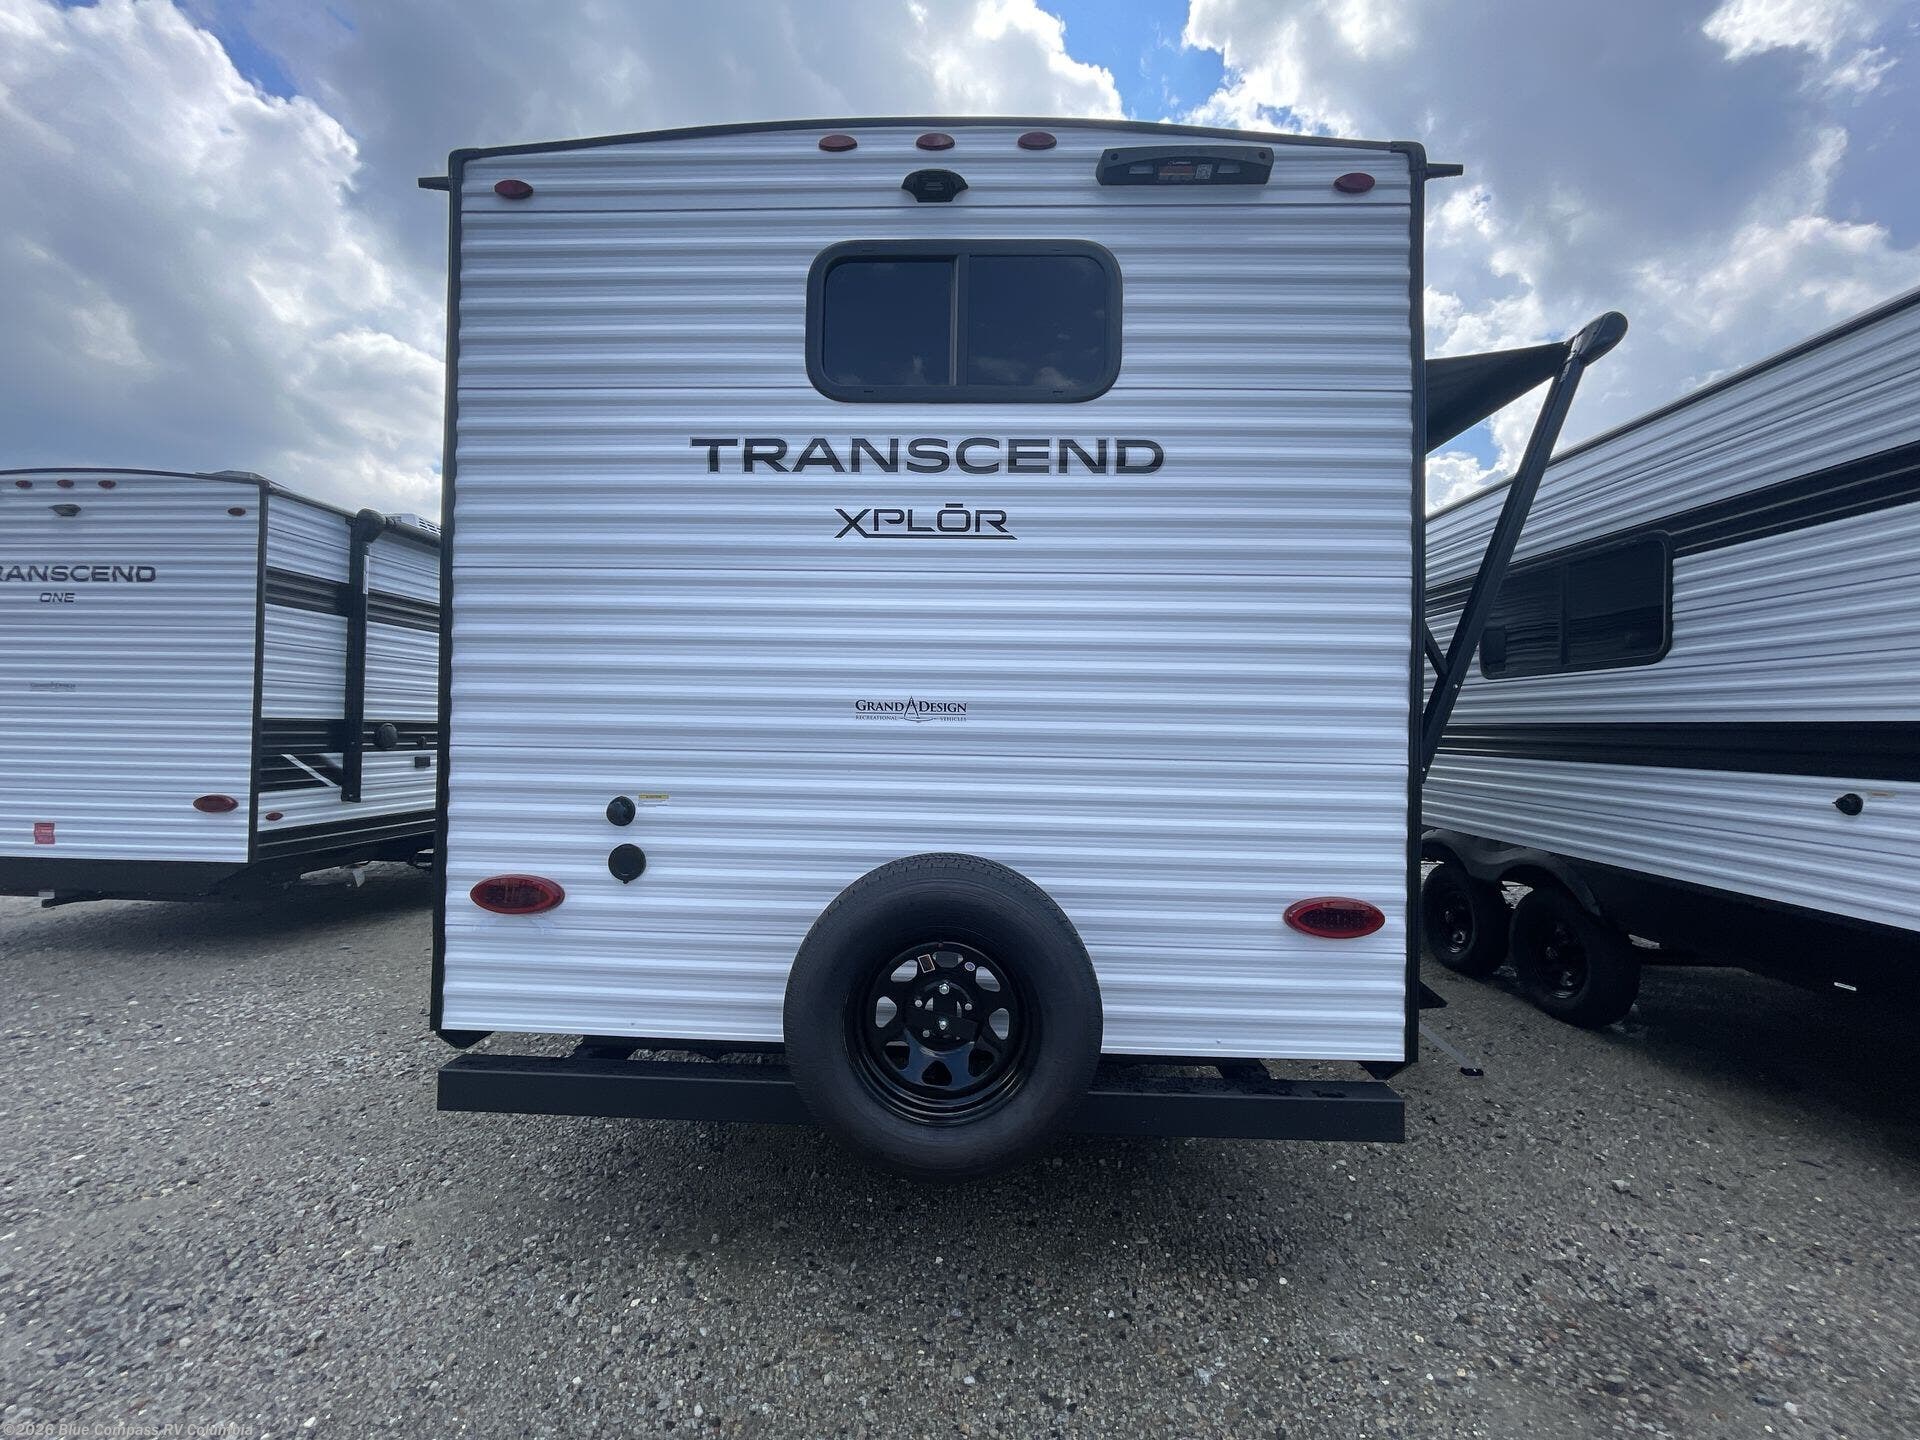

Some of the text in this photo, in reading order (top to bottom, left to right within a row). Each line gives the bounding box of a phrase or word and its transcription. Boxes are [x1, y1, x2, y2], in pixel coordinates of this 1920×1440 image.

[689, 437, 1166, 475] TRANSCEND
[0, 565, 157, 583] ANSCEND
[40, 592, 76, 603] ONE
[855, 700, 968, 713] GRAND DESIGN
